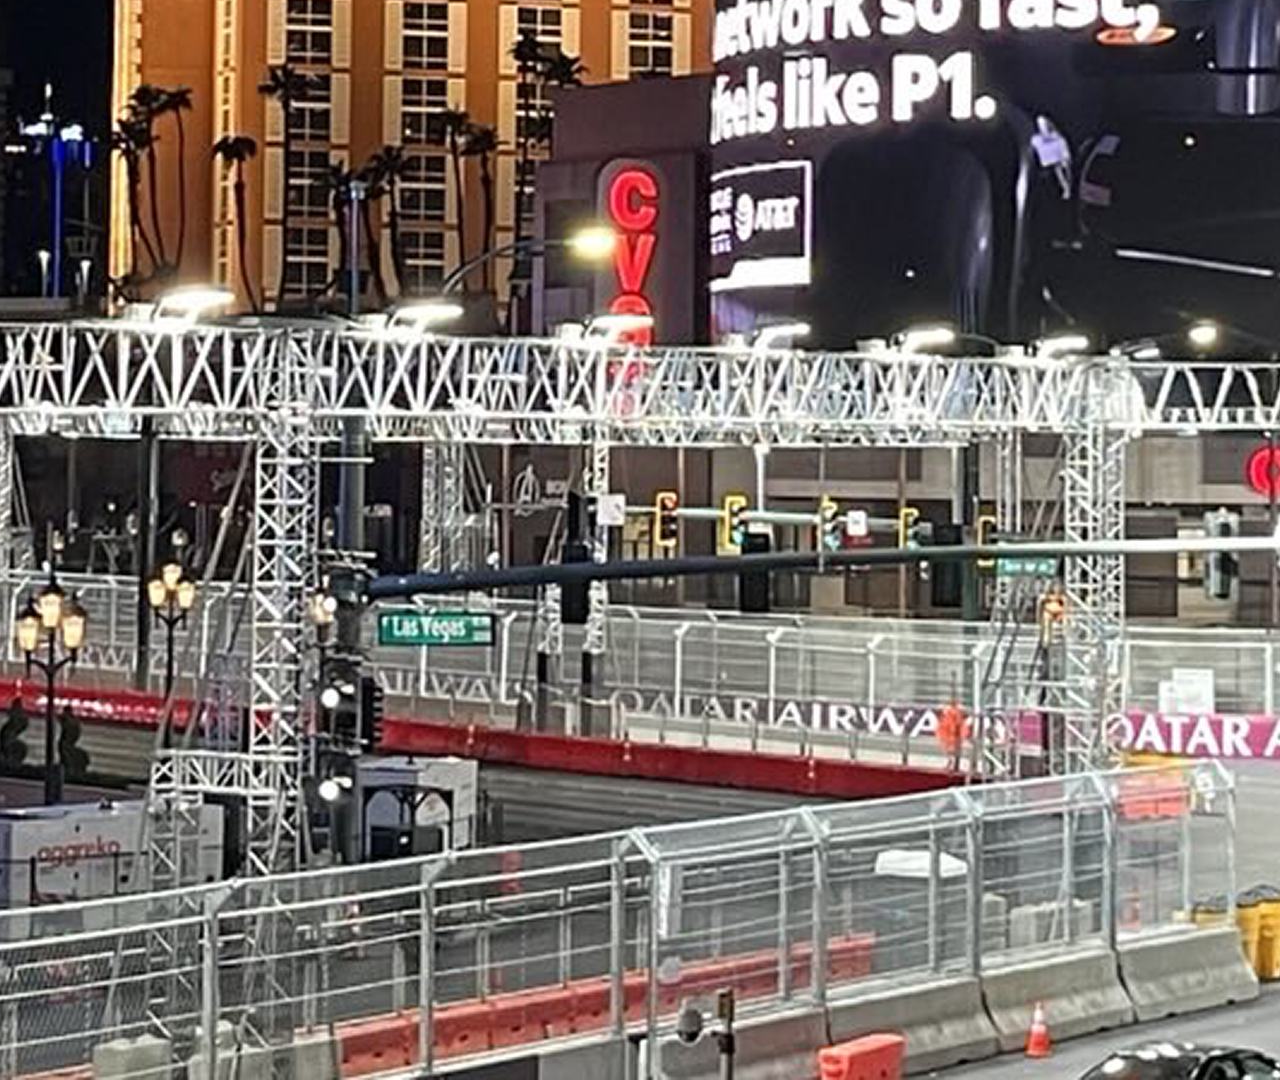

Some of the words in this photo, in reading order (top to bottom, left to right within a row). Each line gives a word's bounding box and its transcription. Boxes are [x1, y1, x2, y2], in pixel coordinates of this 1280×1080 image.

[783, 54, 880, 130] like
[891, 51, 997, 122] P1.
[754, 196, 800, 230] AT&T
[391, 616, 419, 637] Las
[419, 616, 467, 643] Vegas
